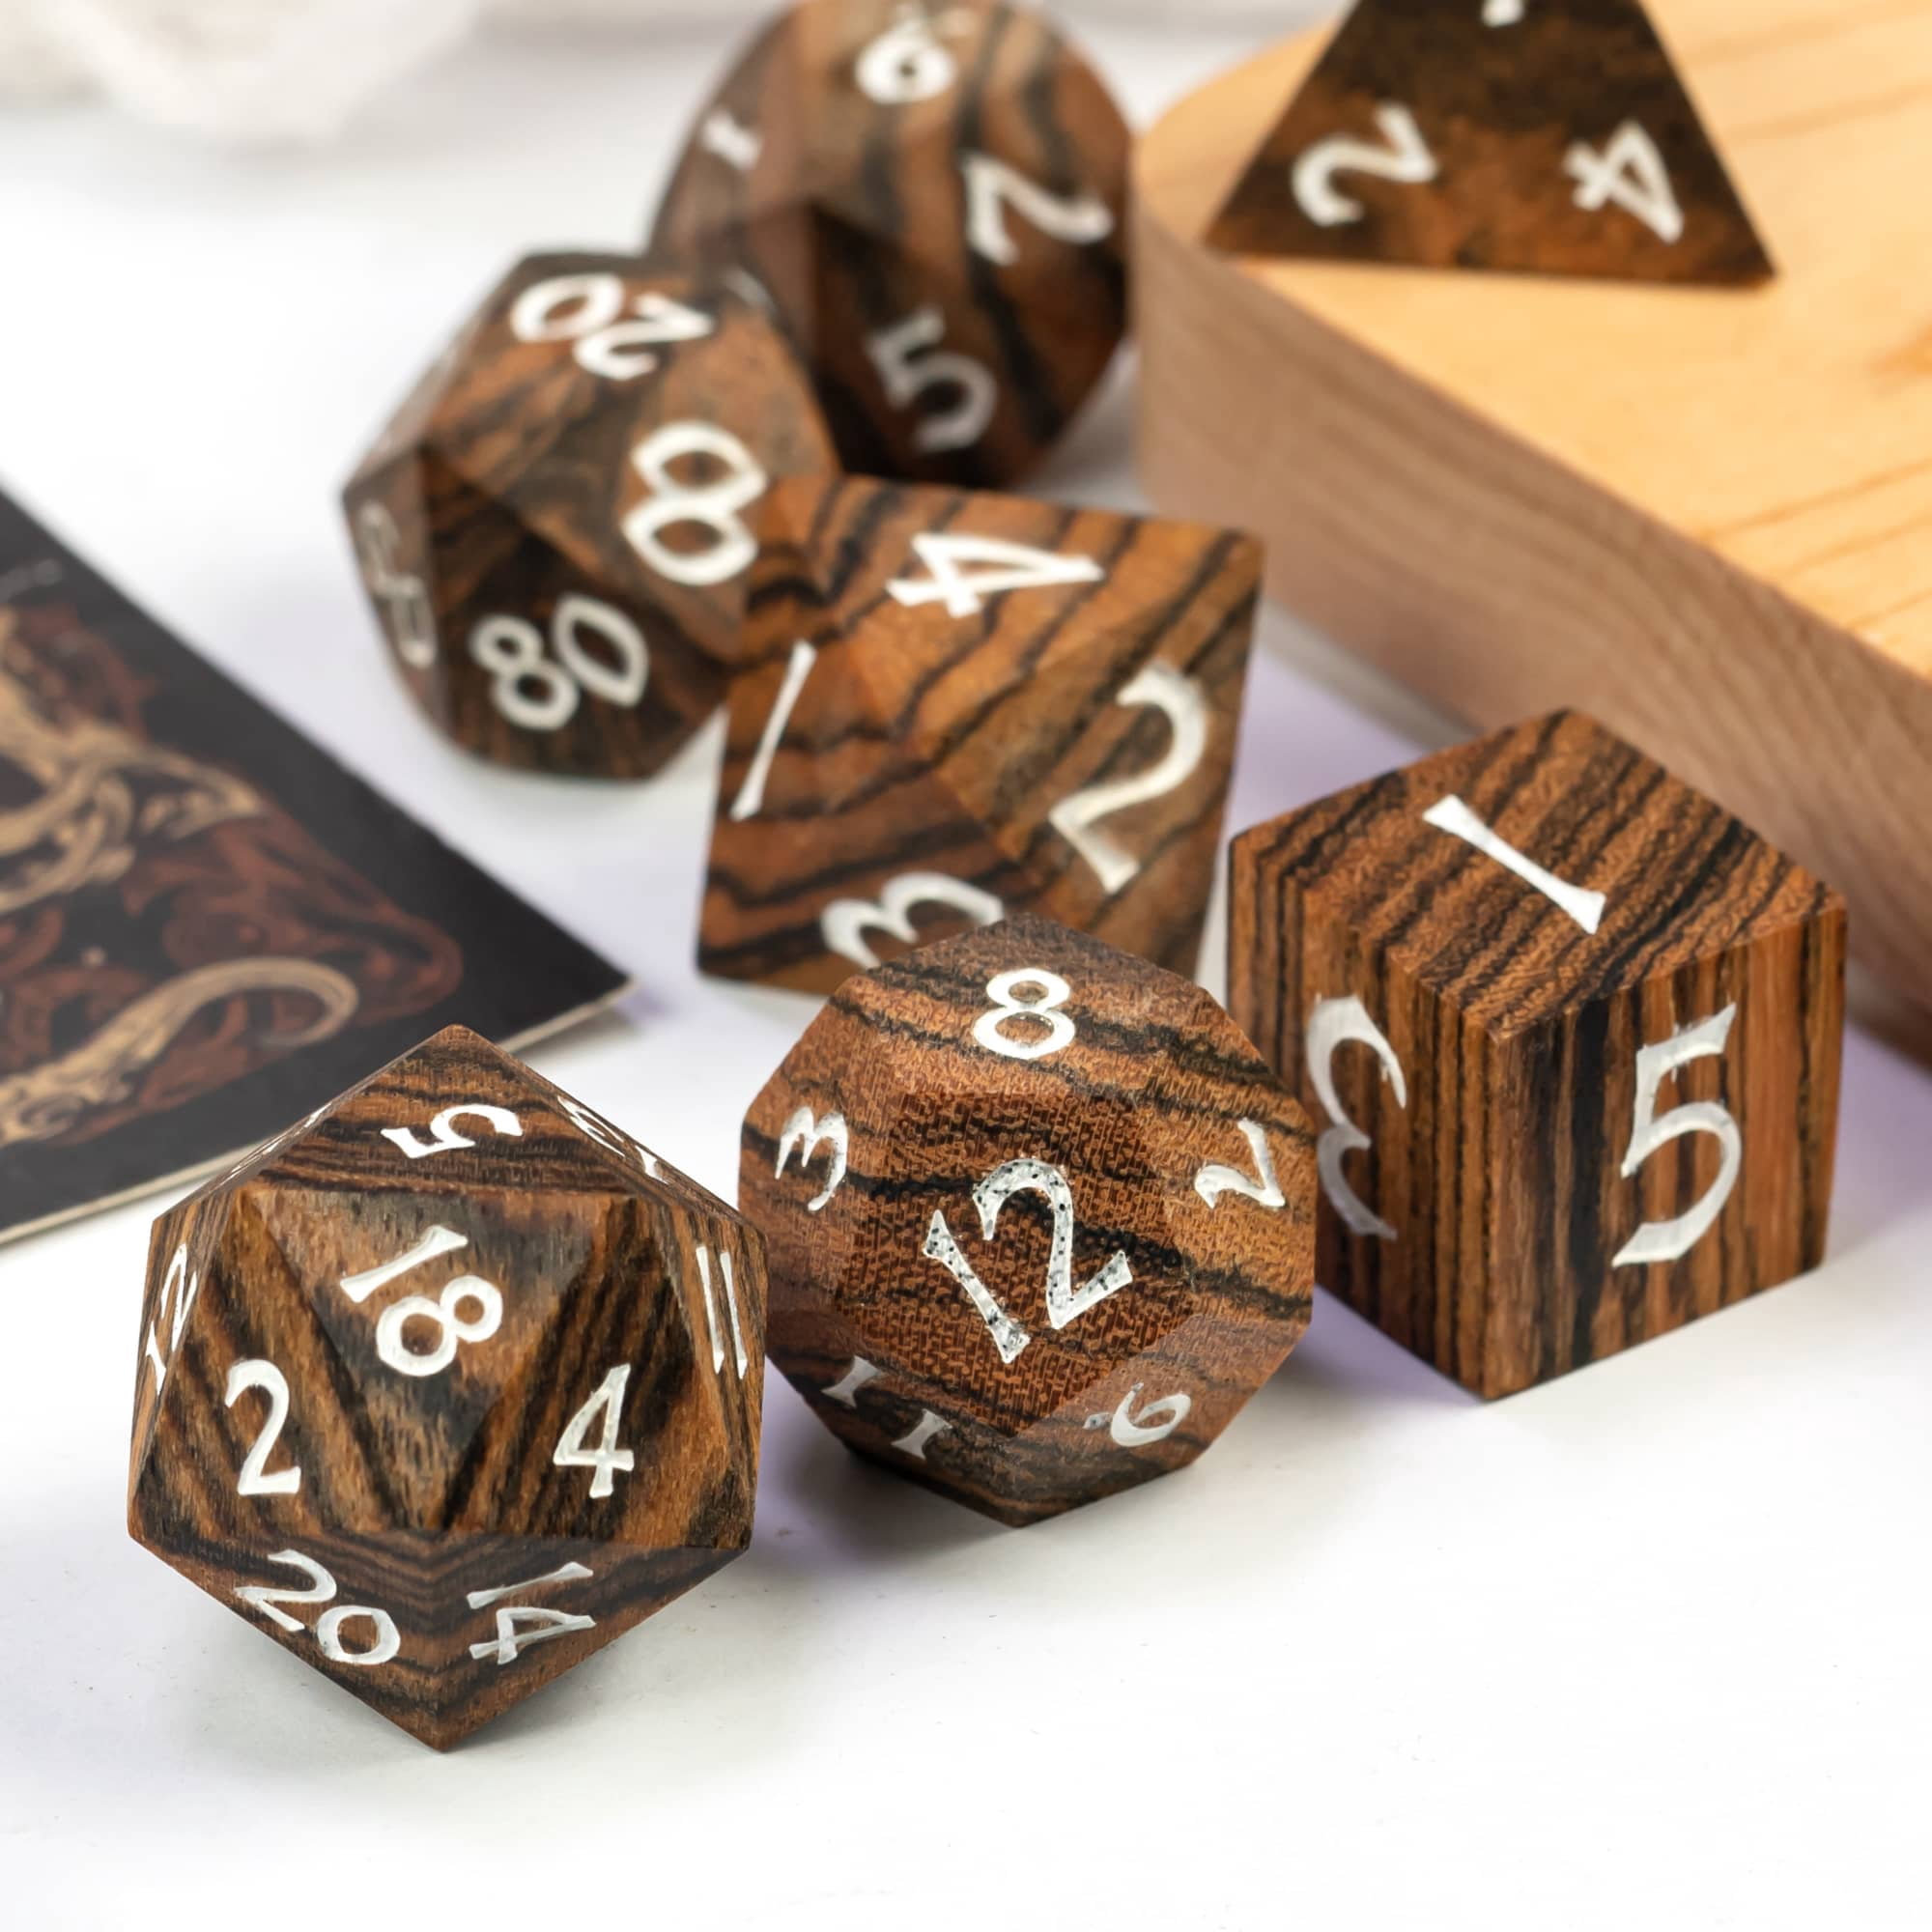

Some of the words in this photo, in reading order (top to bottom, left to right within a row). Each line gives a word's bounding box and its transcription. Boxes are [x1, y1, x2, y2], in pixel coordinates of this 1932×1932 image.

[1291, 100, 1437, 226] 2
[1562, 118, 1684, 243] 4
[869, 306, 998, 452] 5
[885, 530, 1104, 618] 4
[469, 592, 649, 732] 80
[729, 639, 817, 821] 1
[1048, 659, 1208, 894] 2
[821, 870, 1004, 970] 3
[1423, 795, 1605, 934] 1
[972, 967, 1076, 1060] 8
[382, 1104, 523, 1159] 5
[775, 1105, 849, 1211] 3
[1306, 993, 1407, 1241] 3
[1611, 1002, 1742, 1268] 5
[340, 1225, 503, 1378] 18
[696, 1245, 748, 1379] 11
[923, 1157, 1134, 1364] 12
[224, 1358, 301, 1496] 2
[553, 1363, 635, 1499] 4
[233, 1548, 402, 1666] 20
[467, 1561, 597, 1665] 14
